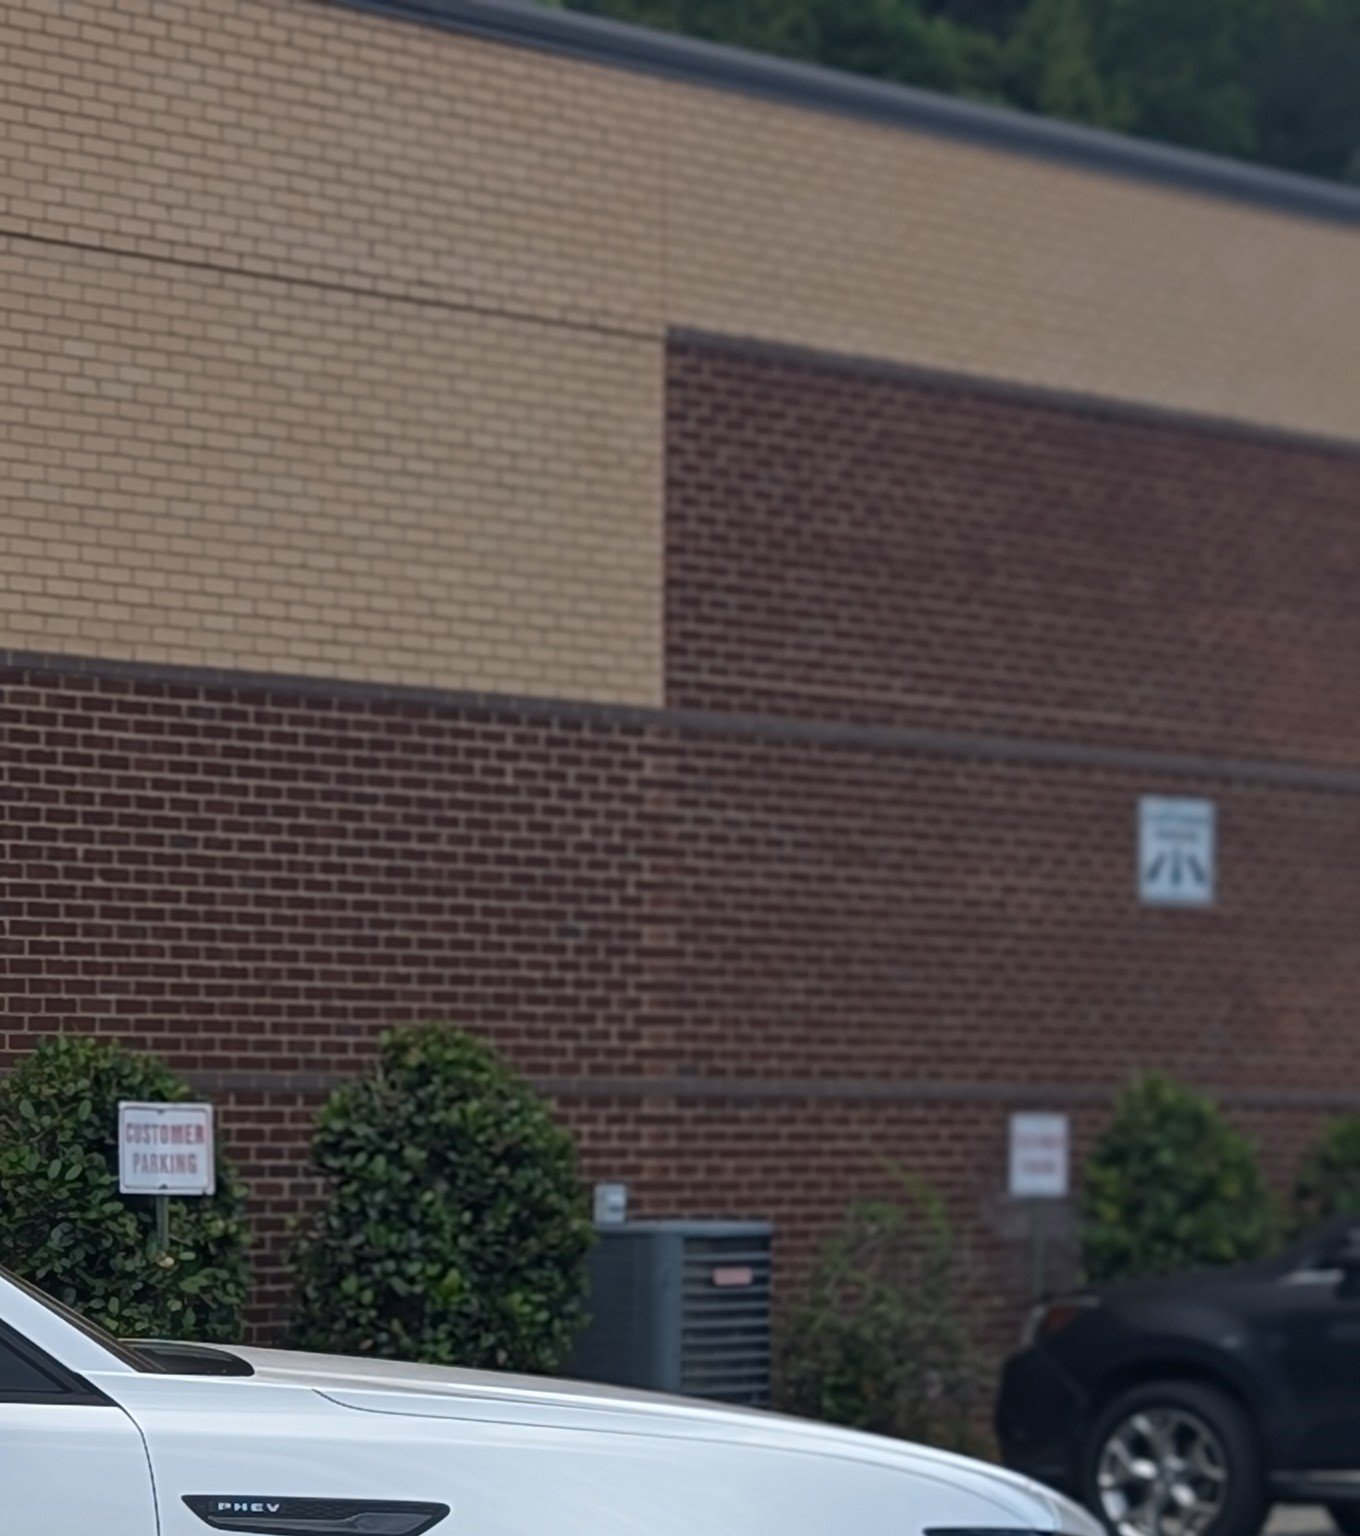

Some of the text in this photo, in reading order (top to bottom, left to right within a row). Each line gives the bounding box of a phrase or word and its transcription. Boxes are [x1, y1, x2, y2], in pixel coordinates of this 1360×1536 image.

[125, 1123, 205, 1144] CUSTOMER
[133, 1153, 197, 1174] PARKING
[218, 1502, 279, 1513] PHEV
